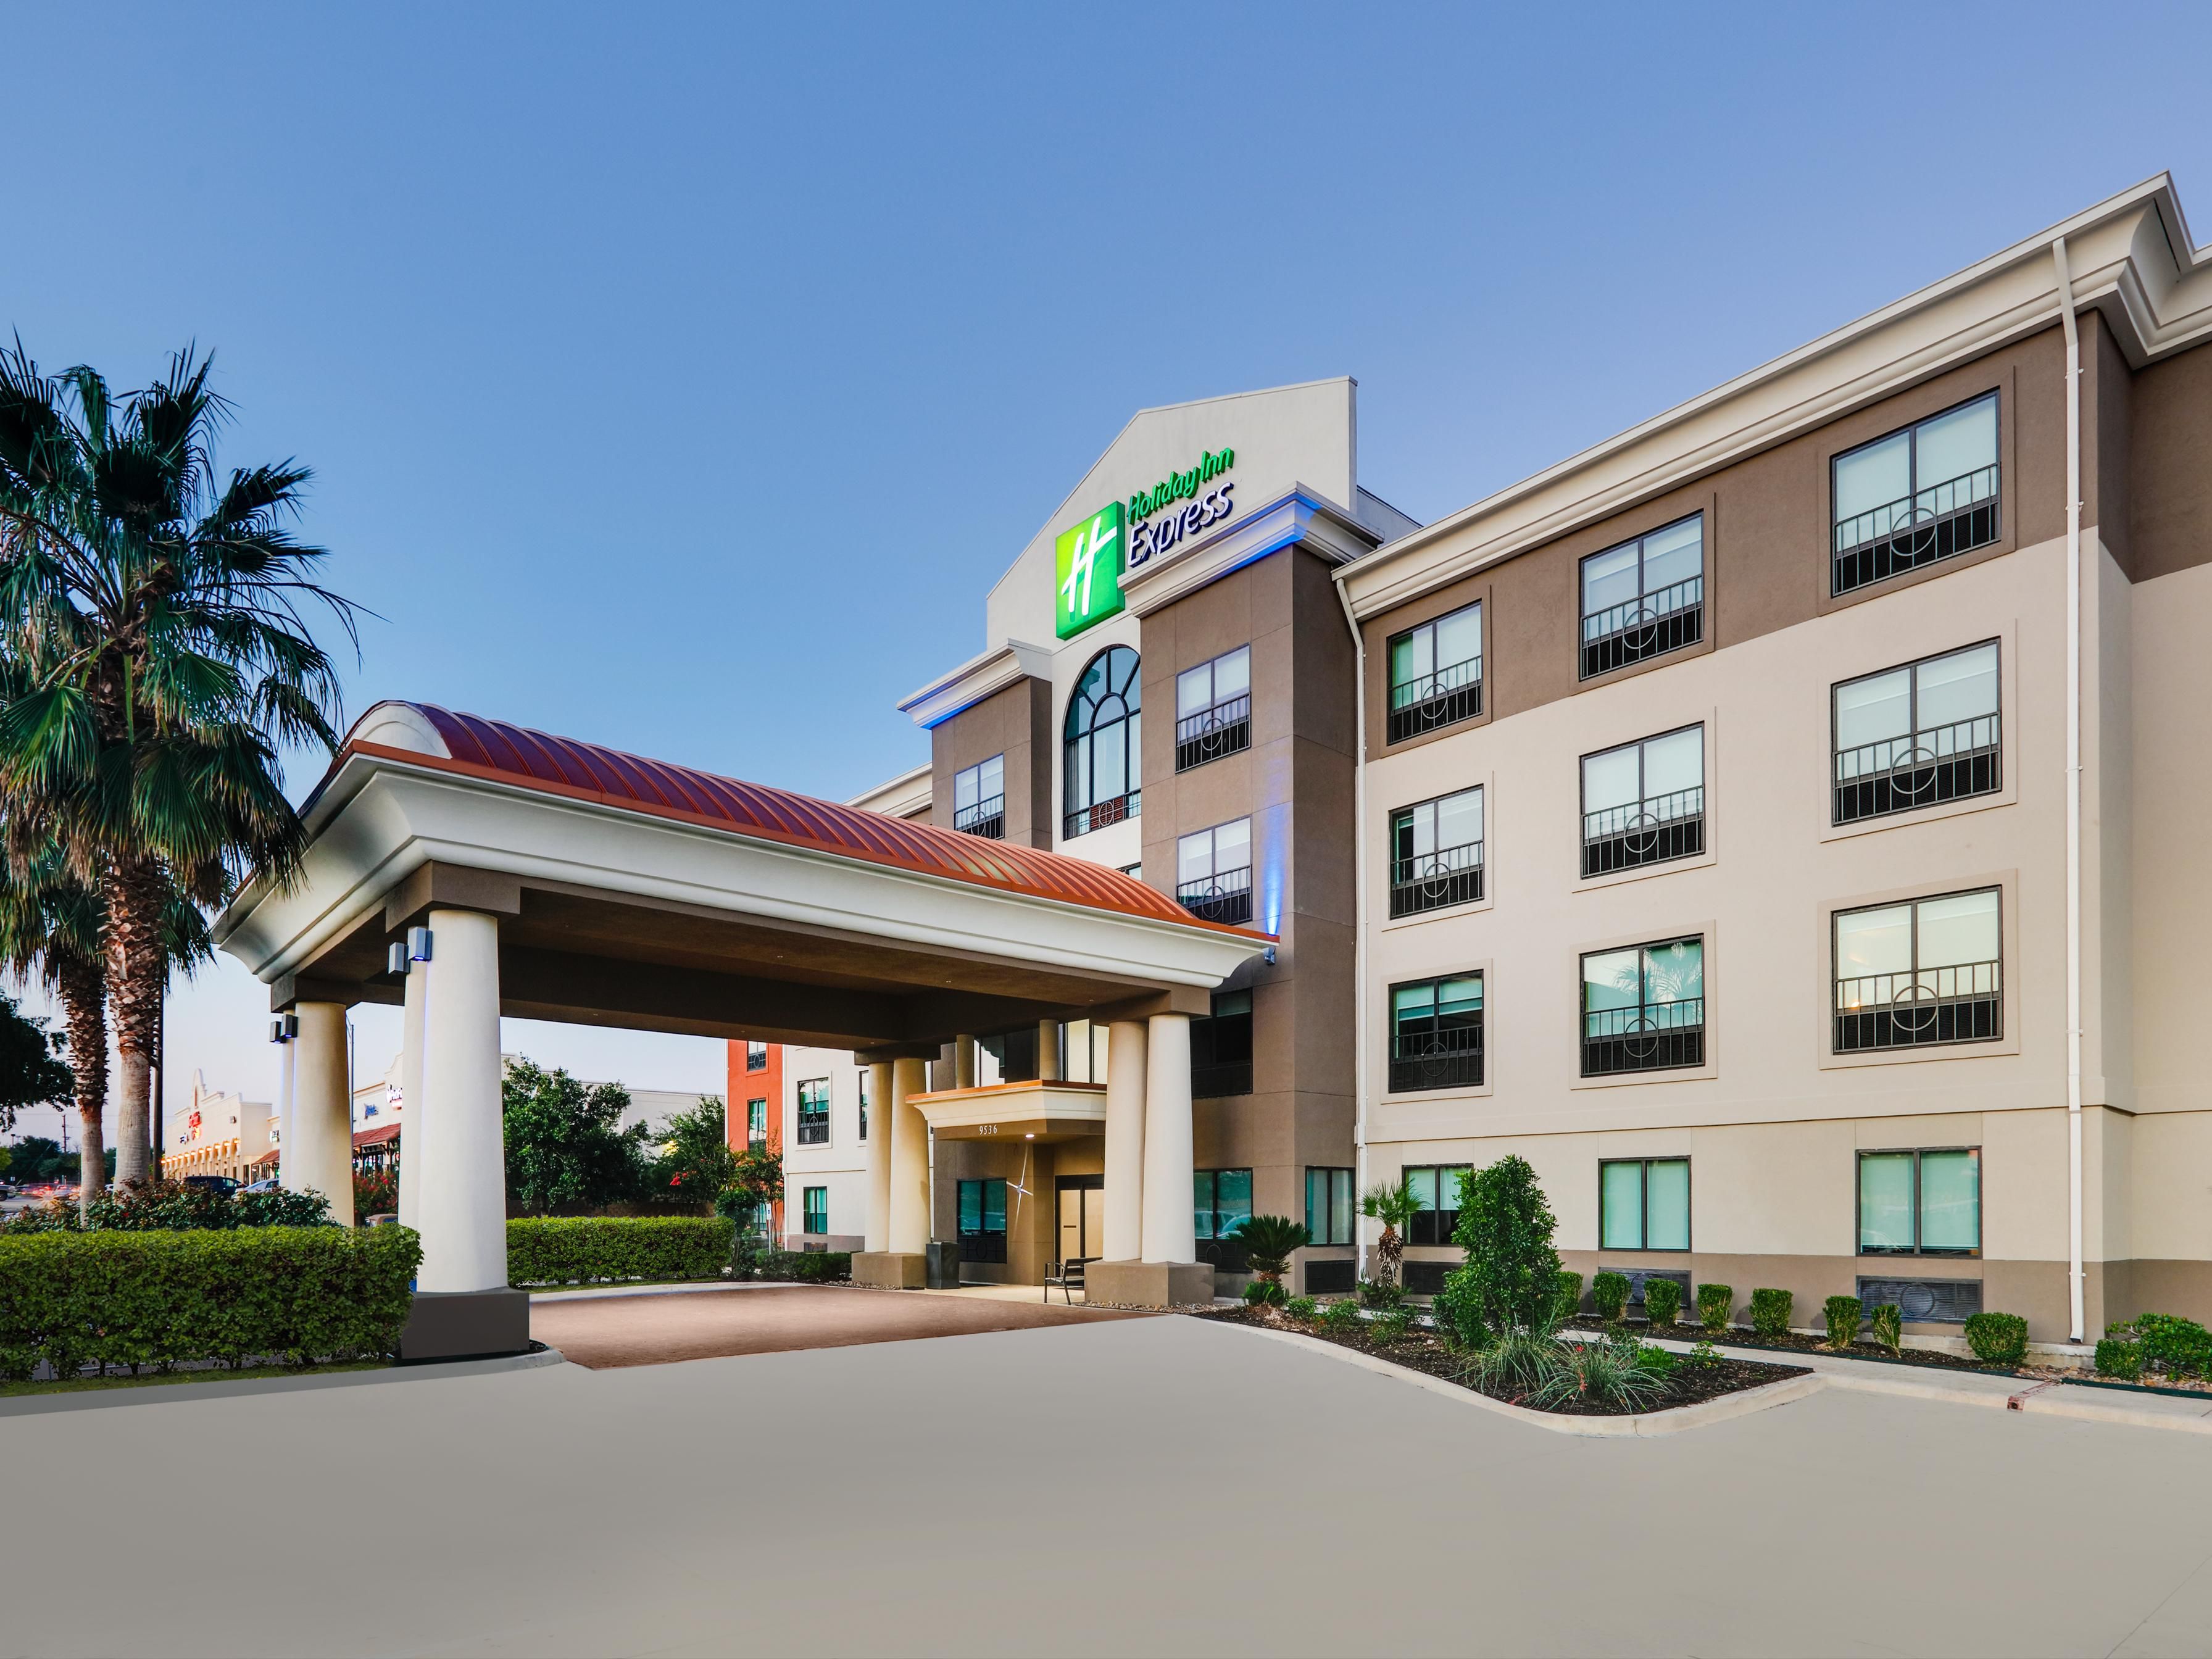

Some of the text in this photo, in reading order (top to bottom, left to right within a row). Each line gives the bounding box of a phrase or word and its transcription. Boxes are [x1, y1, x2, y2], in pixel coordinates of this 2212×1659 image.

[1127, 447, 1234, 525] Holiday Inn
[1128, 482, 1234, 567] Express
[979, 1125, 997, 1135] 9536
